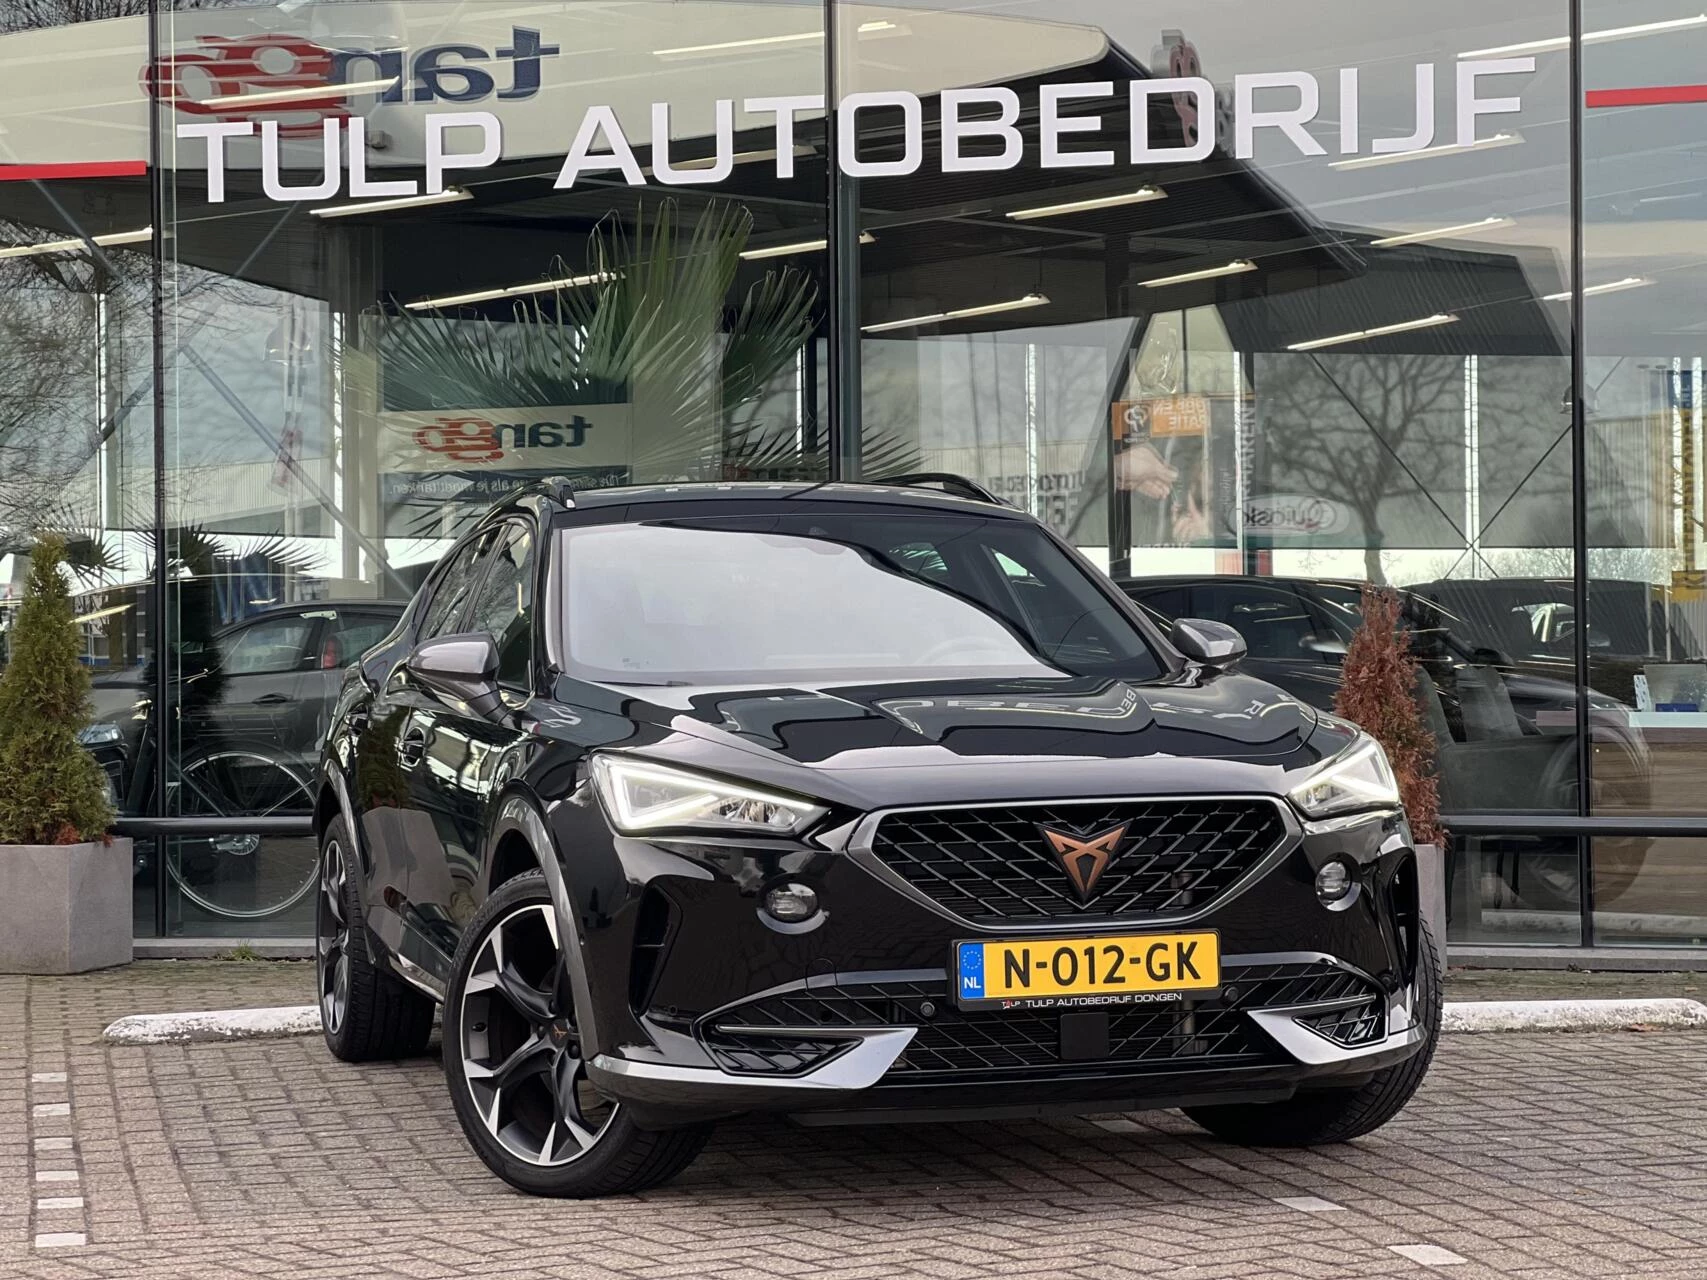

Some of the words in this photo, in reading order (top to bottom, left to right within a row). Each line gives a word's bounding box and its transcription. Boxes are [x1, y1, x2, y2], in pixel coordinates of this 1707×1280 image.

[177, 112, 501, 203] TULP
[556, 57, 1536, 189] AUTOBEDRIJF
[1004, 941, 1201, 989] N-012-GK
[964, 976, 981, 989] NL
[1025, 998, 1054, 1008] TULP
[1056, 995, 1132, 1007] AUTOBEDRIJF
[1135, 992, 1182, 1003] DONGEN
